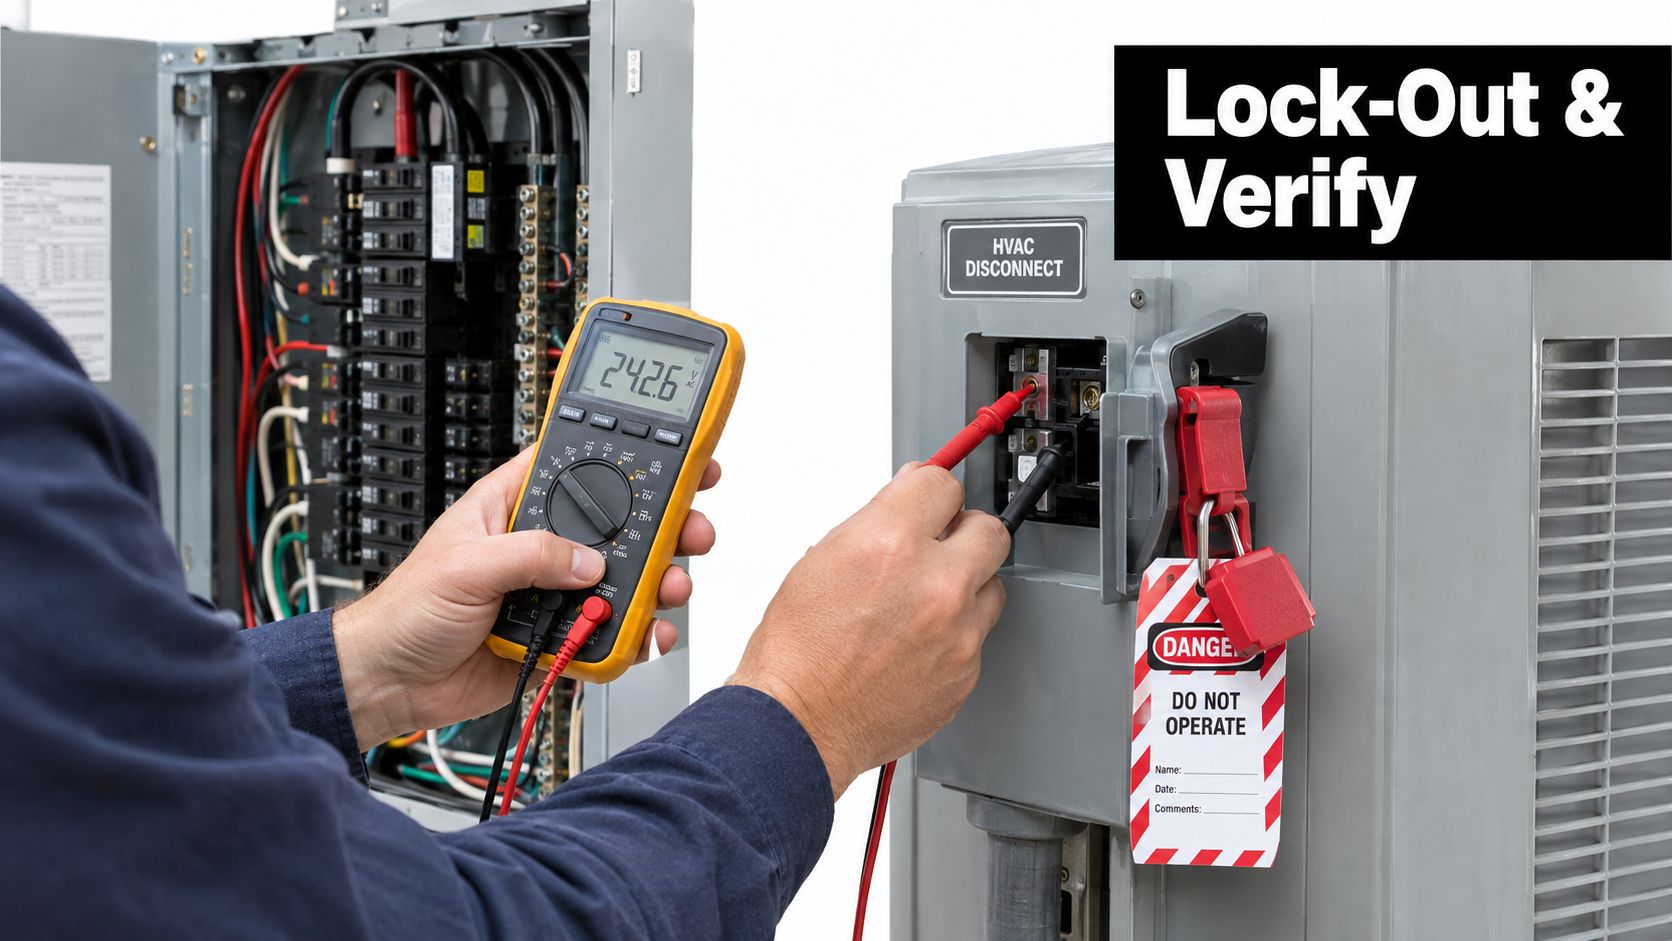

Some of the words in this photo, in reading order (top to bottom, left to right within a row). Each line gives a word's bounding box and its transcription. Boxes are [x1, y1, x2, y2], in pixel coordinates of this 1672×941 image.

[993, 237, 1035, 255] HVAC
[965, 259, 1064, 277] DISCONNECT
[1163, 636, 1240, 658] DANGE
[1172, 691, 1197, 711] DO
[1204, 691, 1241, 711] NOT
[1165, 716, 1247, 736] OPERATE
[1155, 765, 1182, 775] Name:
[1155, 784, 1177, 794] Date:
[1155, 804, 1202, 814] Comments:
